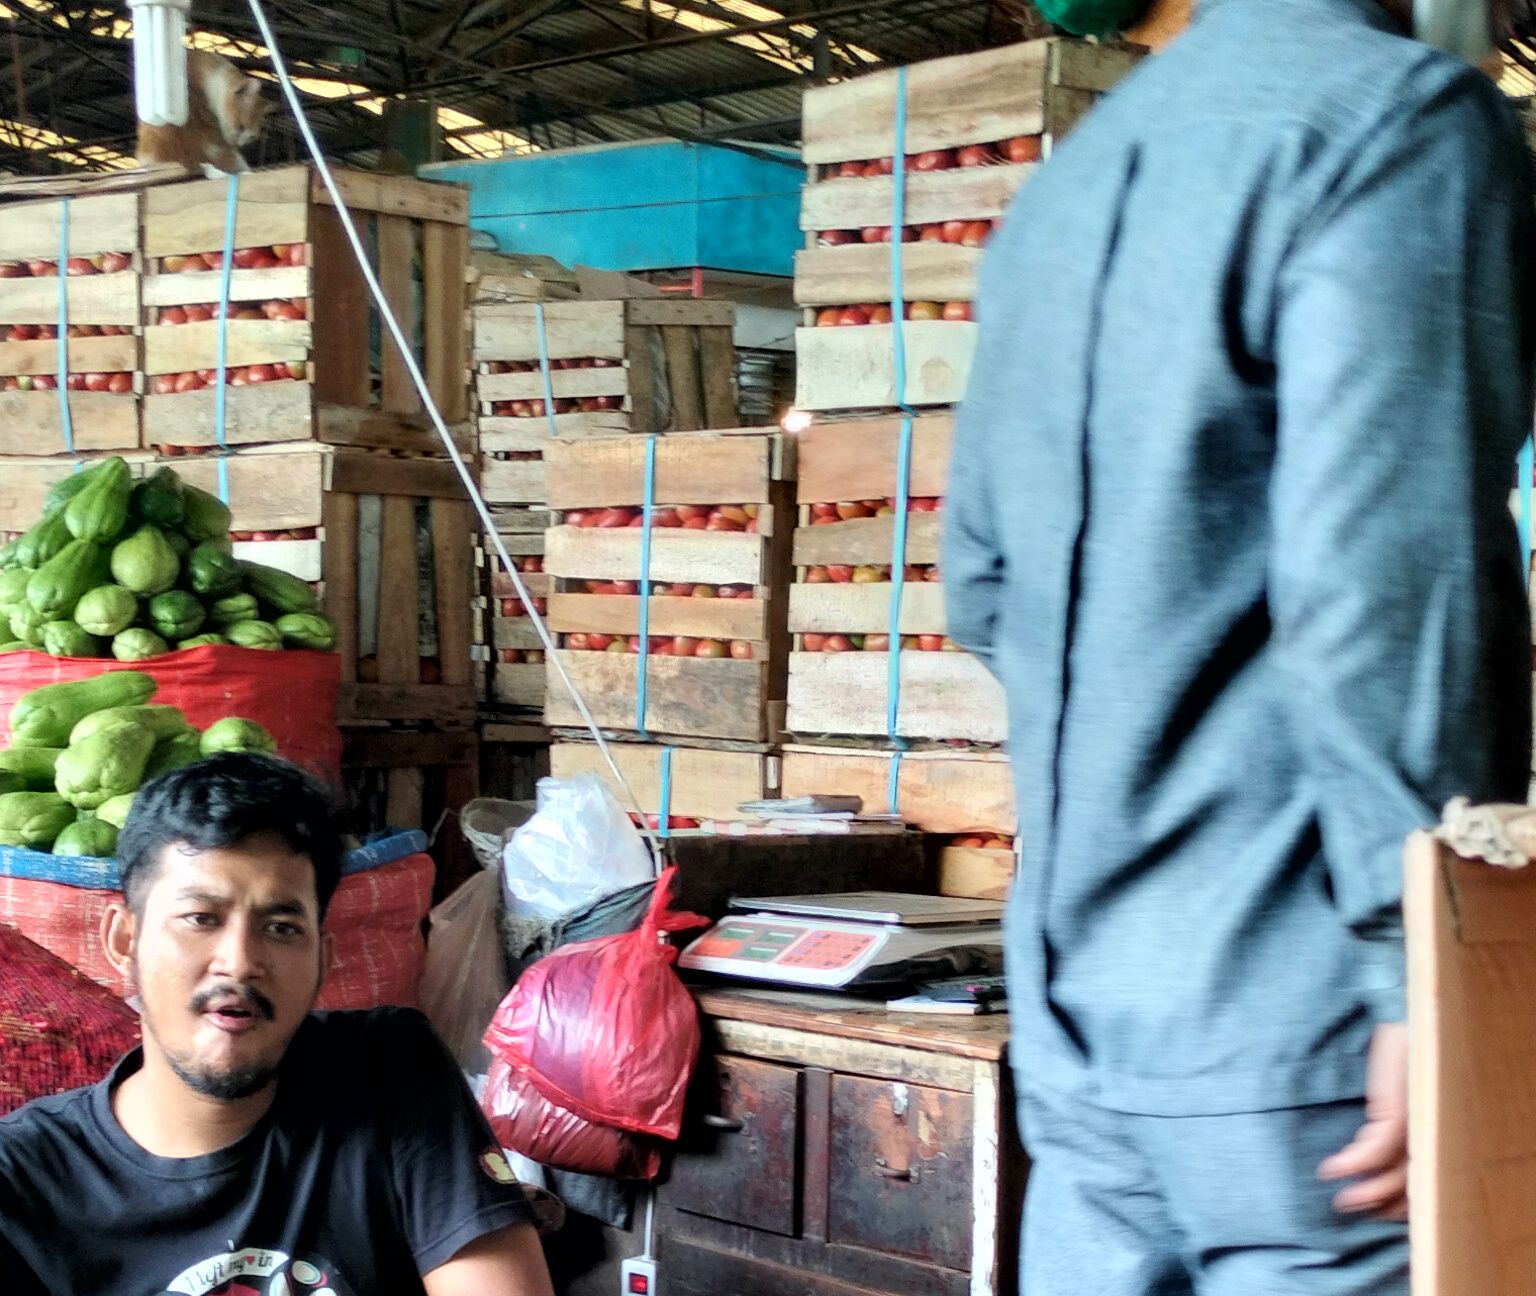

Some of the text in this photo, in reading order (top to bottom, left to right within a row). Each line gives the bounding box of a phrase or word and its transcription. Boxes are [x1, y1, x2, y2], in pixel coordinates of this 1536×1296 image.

[195, 1261, 225, 1287] left
[228, 1256, 244, 1274] my
[257, 1250, 274, 1268] in
